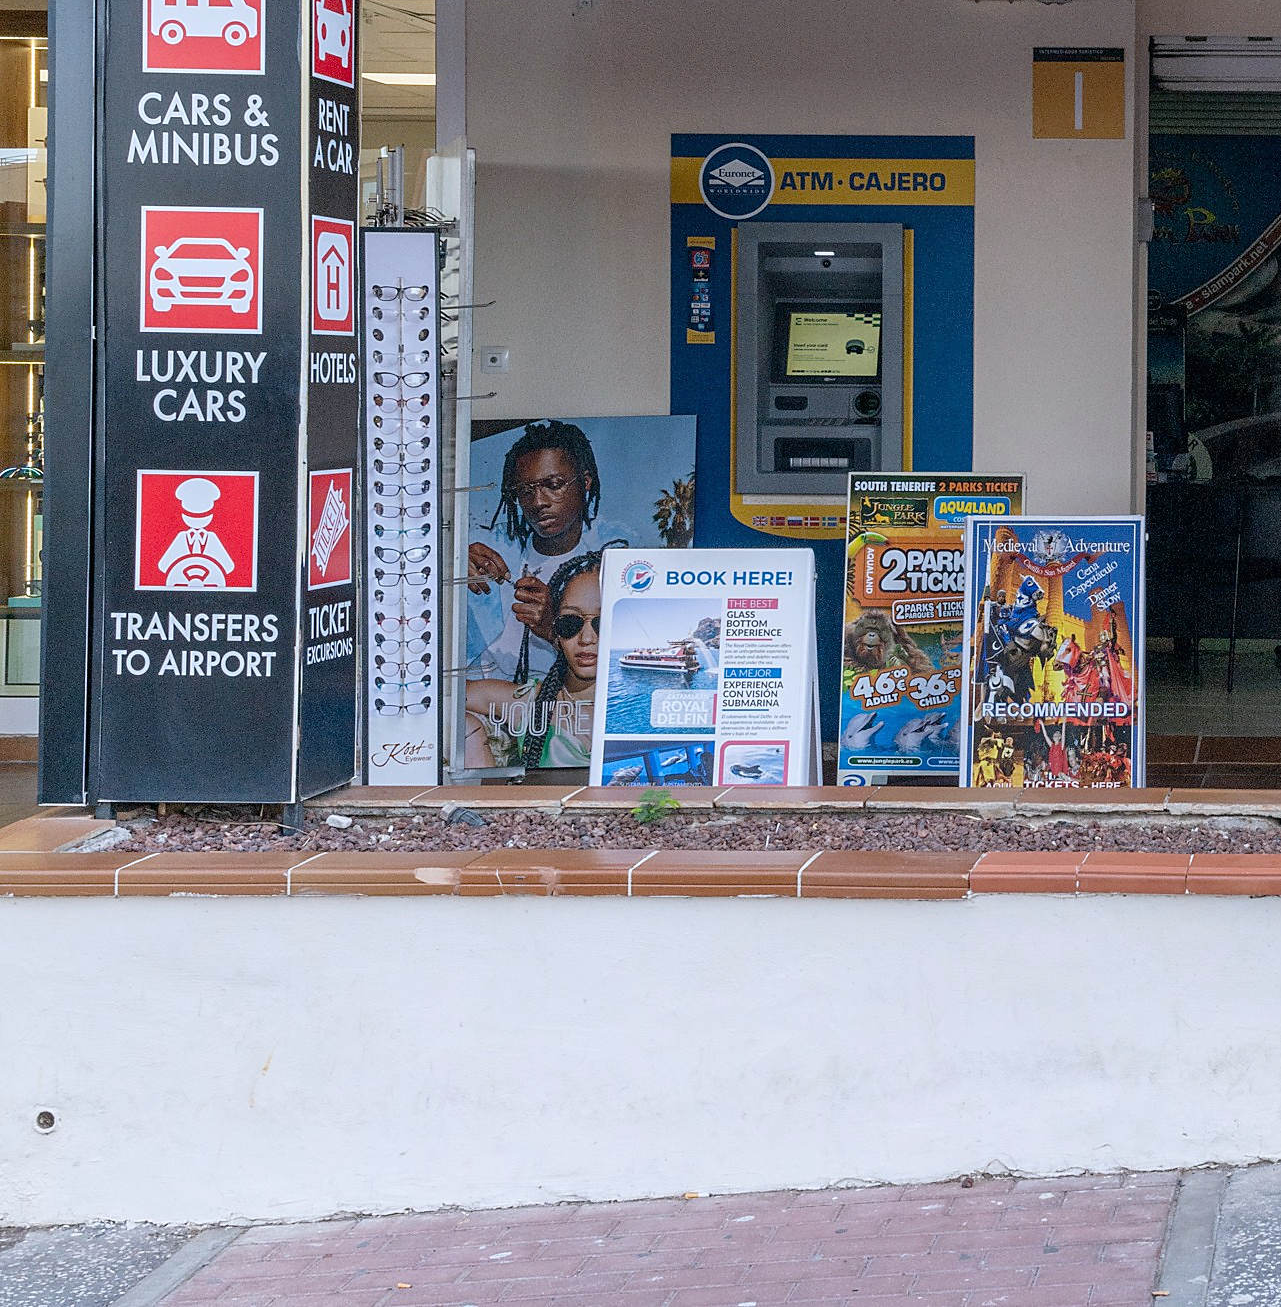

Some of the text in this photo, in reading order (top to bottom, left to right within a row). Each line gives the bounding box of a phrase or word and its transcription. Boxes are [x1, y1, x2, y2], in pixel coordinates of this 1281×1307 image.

[138, 92, 270, 127] CARS &
[318, 98, 350, 136] RENT
[127, 130, 279, 167] MINIBUS
[314, 136, 353, 175] A CAR
[719, 168, 756, 178] Euronet
[780, 171, 946, 192] ATM CAJERO
[136, 350, 267, 384] LUXURY
[311, 352, 356, 384] HOTELS
[153, 390, 246, 422] CARS
[854, 481, 1018, 493] SOUTH TENERIFE 2 PARKS TICKET
[894, 510, 926, 522] PARK
[939, 502, 1006, 515] AQUALAND
[983, 537, 1130, 554] Medieval Adventure
[907, 551, 964, 571] PARK
[866, 547, 874, 594] AQUALAND
[881, 549, 905, 591] 2
[1077, 563, 1100, 579] Cena
[666, 571, 727, 585] BOOK
[733, 571, 793, 586] HERE!
[907, 572, 964, 592] TICKE
[1085, 582, 1118, 606] Dinner
[1097, 592, 1120, 611] Show
[729, 599, 772, 608] THE BEST
[904, 603, 934, 613] PARKS
[309, 600, 351, 639] TICKET
[726, 611, 755, 619] GLASS
[111, 612, 278, 642] TRANSFERS
[726, 629, 782, 637] EXPERIENCE
[307, 637, 353, 666] EXCURSIONS
[113, 648, 277, 678] TO AIRPORT
[725, 670, 772, 678] LA MEJOR
[723, 681, 784, 689] EXPERIENCIA
[723, 688, 778, 698] CON VISIÓN
[662, 700, 708, 712] ROYAL
[722, 699, 779, 707] SUBMARINA
[865, 693, 899, 707] ADULT
[919, 695, 949, 707] CHILD
[982, 702, 1128, 717] RECOMMENDED
[489, 700, 595, 737] YOU'RE
[657, 713, 708, 724] DELFIN
[405, 755, 432, 764] Eyewear
